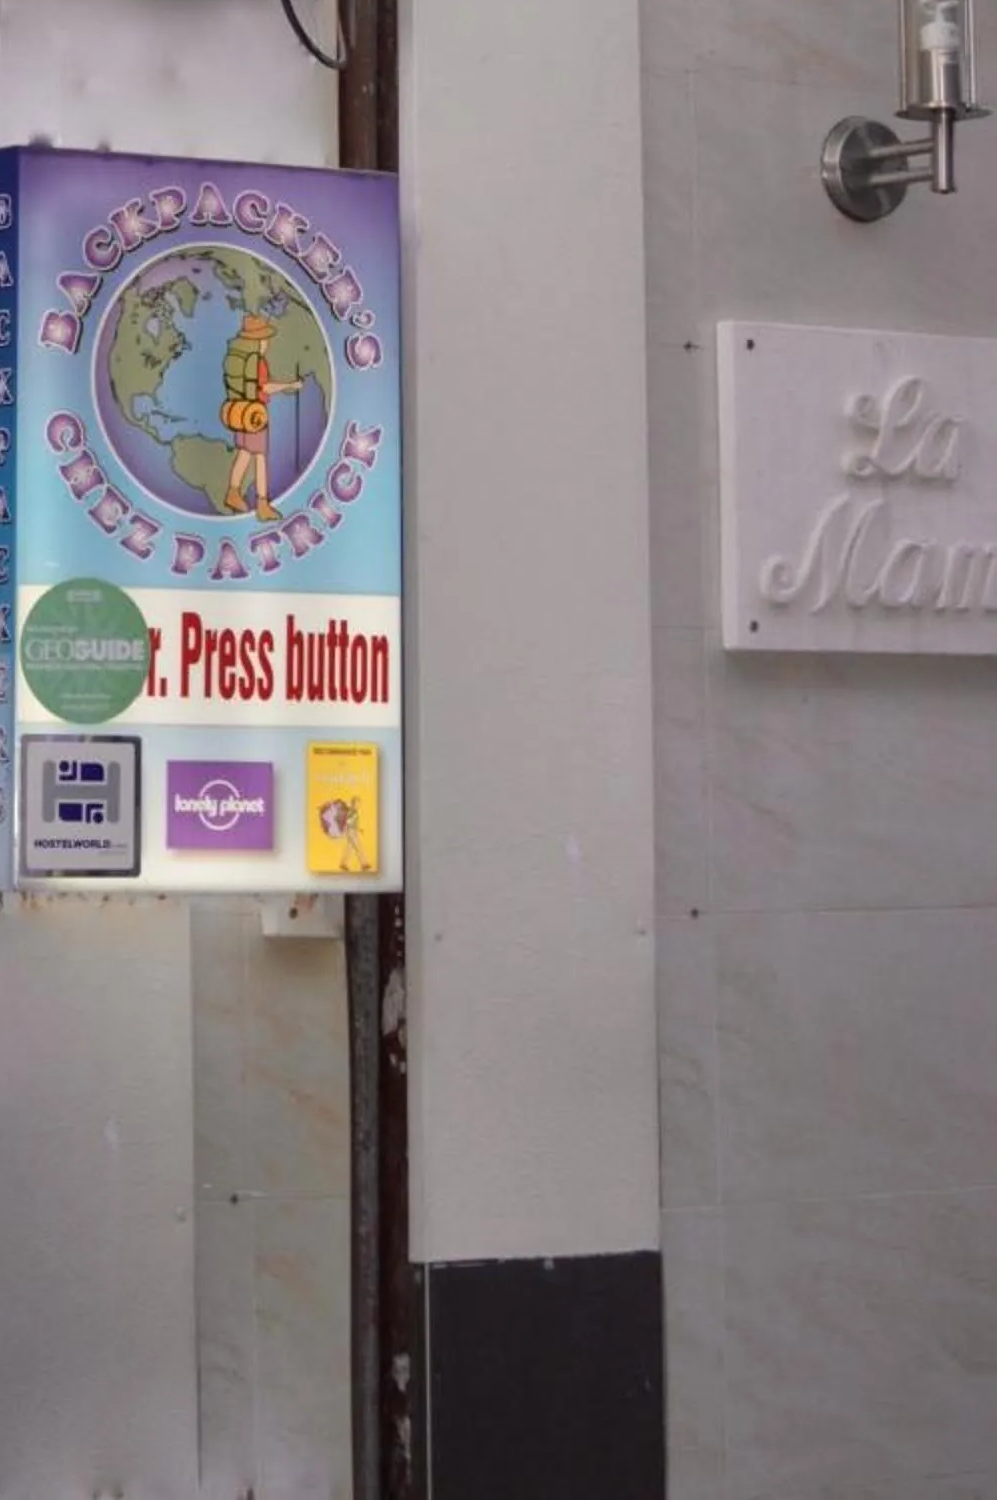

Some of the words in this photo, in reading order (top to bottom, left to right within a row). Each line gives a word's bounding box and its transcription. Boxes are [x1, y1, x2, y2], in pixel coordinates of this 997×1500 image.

[840, 373, 965, 481] La
[44, 409, 162, 561] CHEZ
[171, 420, 384, 582] PATRICK
[180, 611, 275, 701] Press
[286, 613, 389, 705] button
[174, 793, 218, 818] lonely
[219, 795, 265, 818] planet
